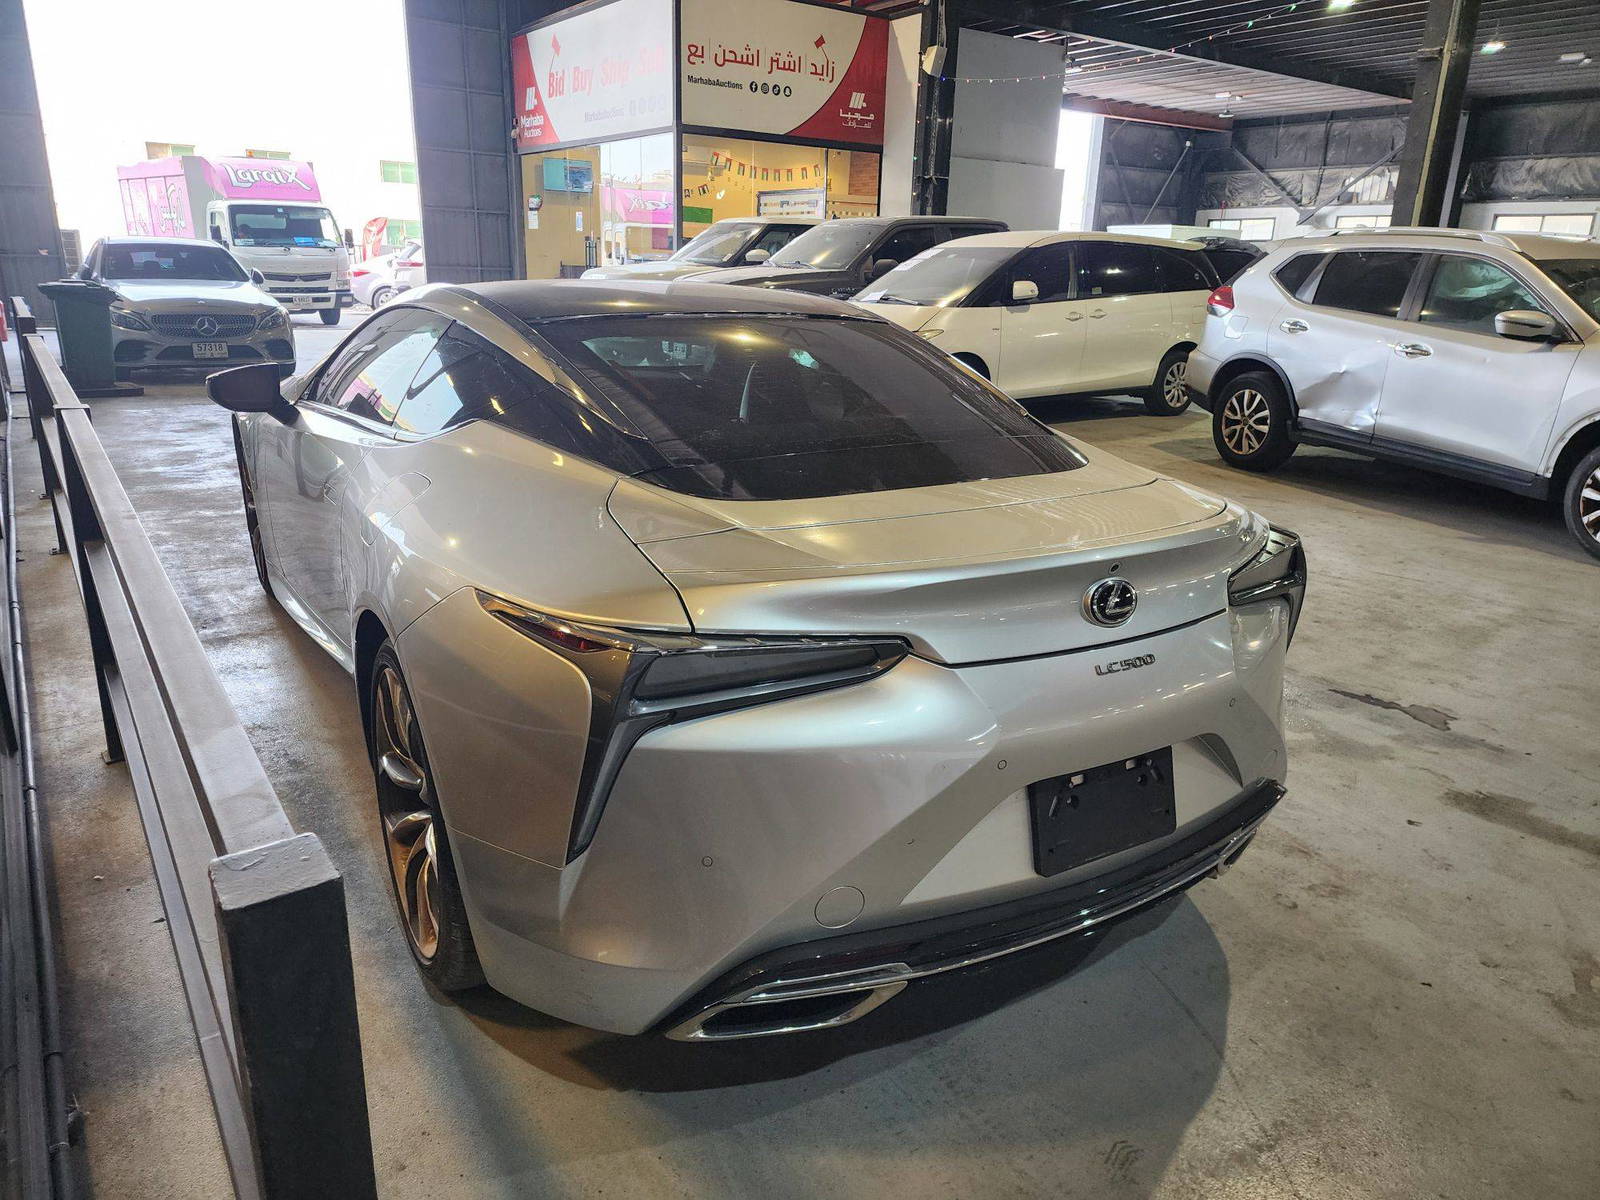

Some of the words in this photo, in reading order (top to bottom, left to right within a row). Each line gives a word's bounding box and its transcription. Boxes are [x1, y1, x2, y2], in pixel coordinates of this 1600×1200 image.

[687, 43, 705, 65] بع
[714, 43, 760, 67] اشحن
[768, 50, 802, 74] اشتر
[548, 68, 565, 99] Bid
[572, 65, 593, 96] Buy
[687, 74, 743, 90] MarhabaAuctions
[521, 113, 545, 128] Marhaba
[197, 343, 223, 352] 57318
